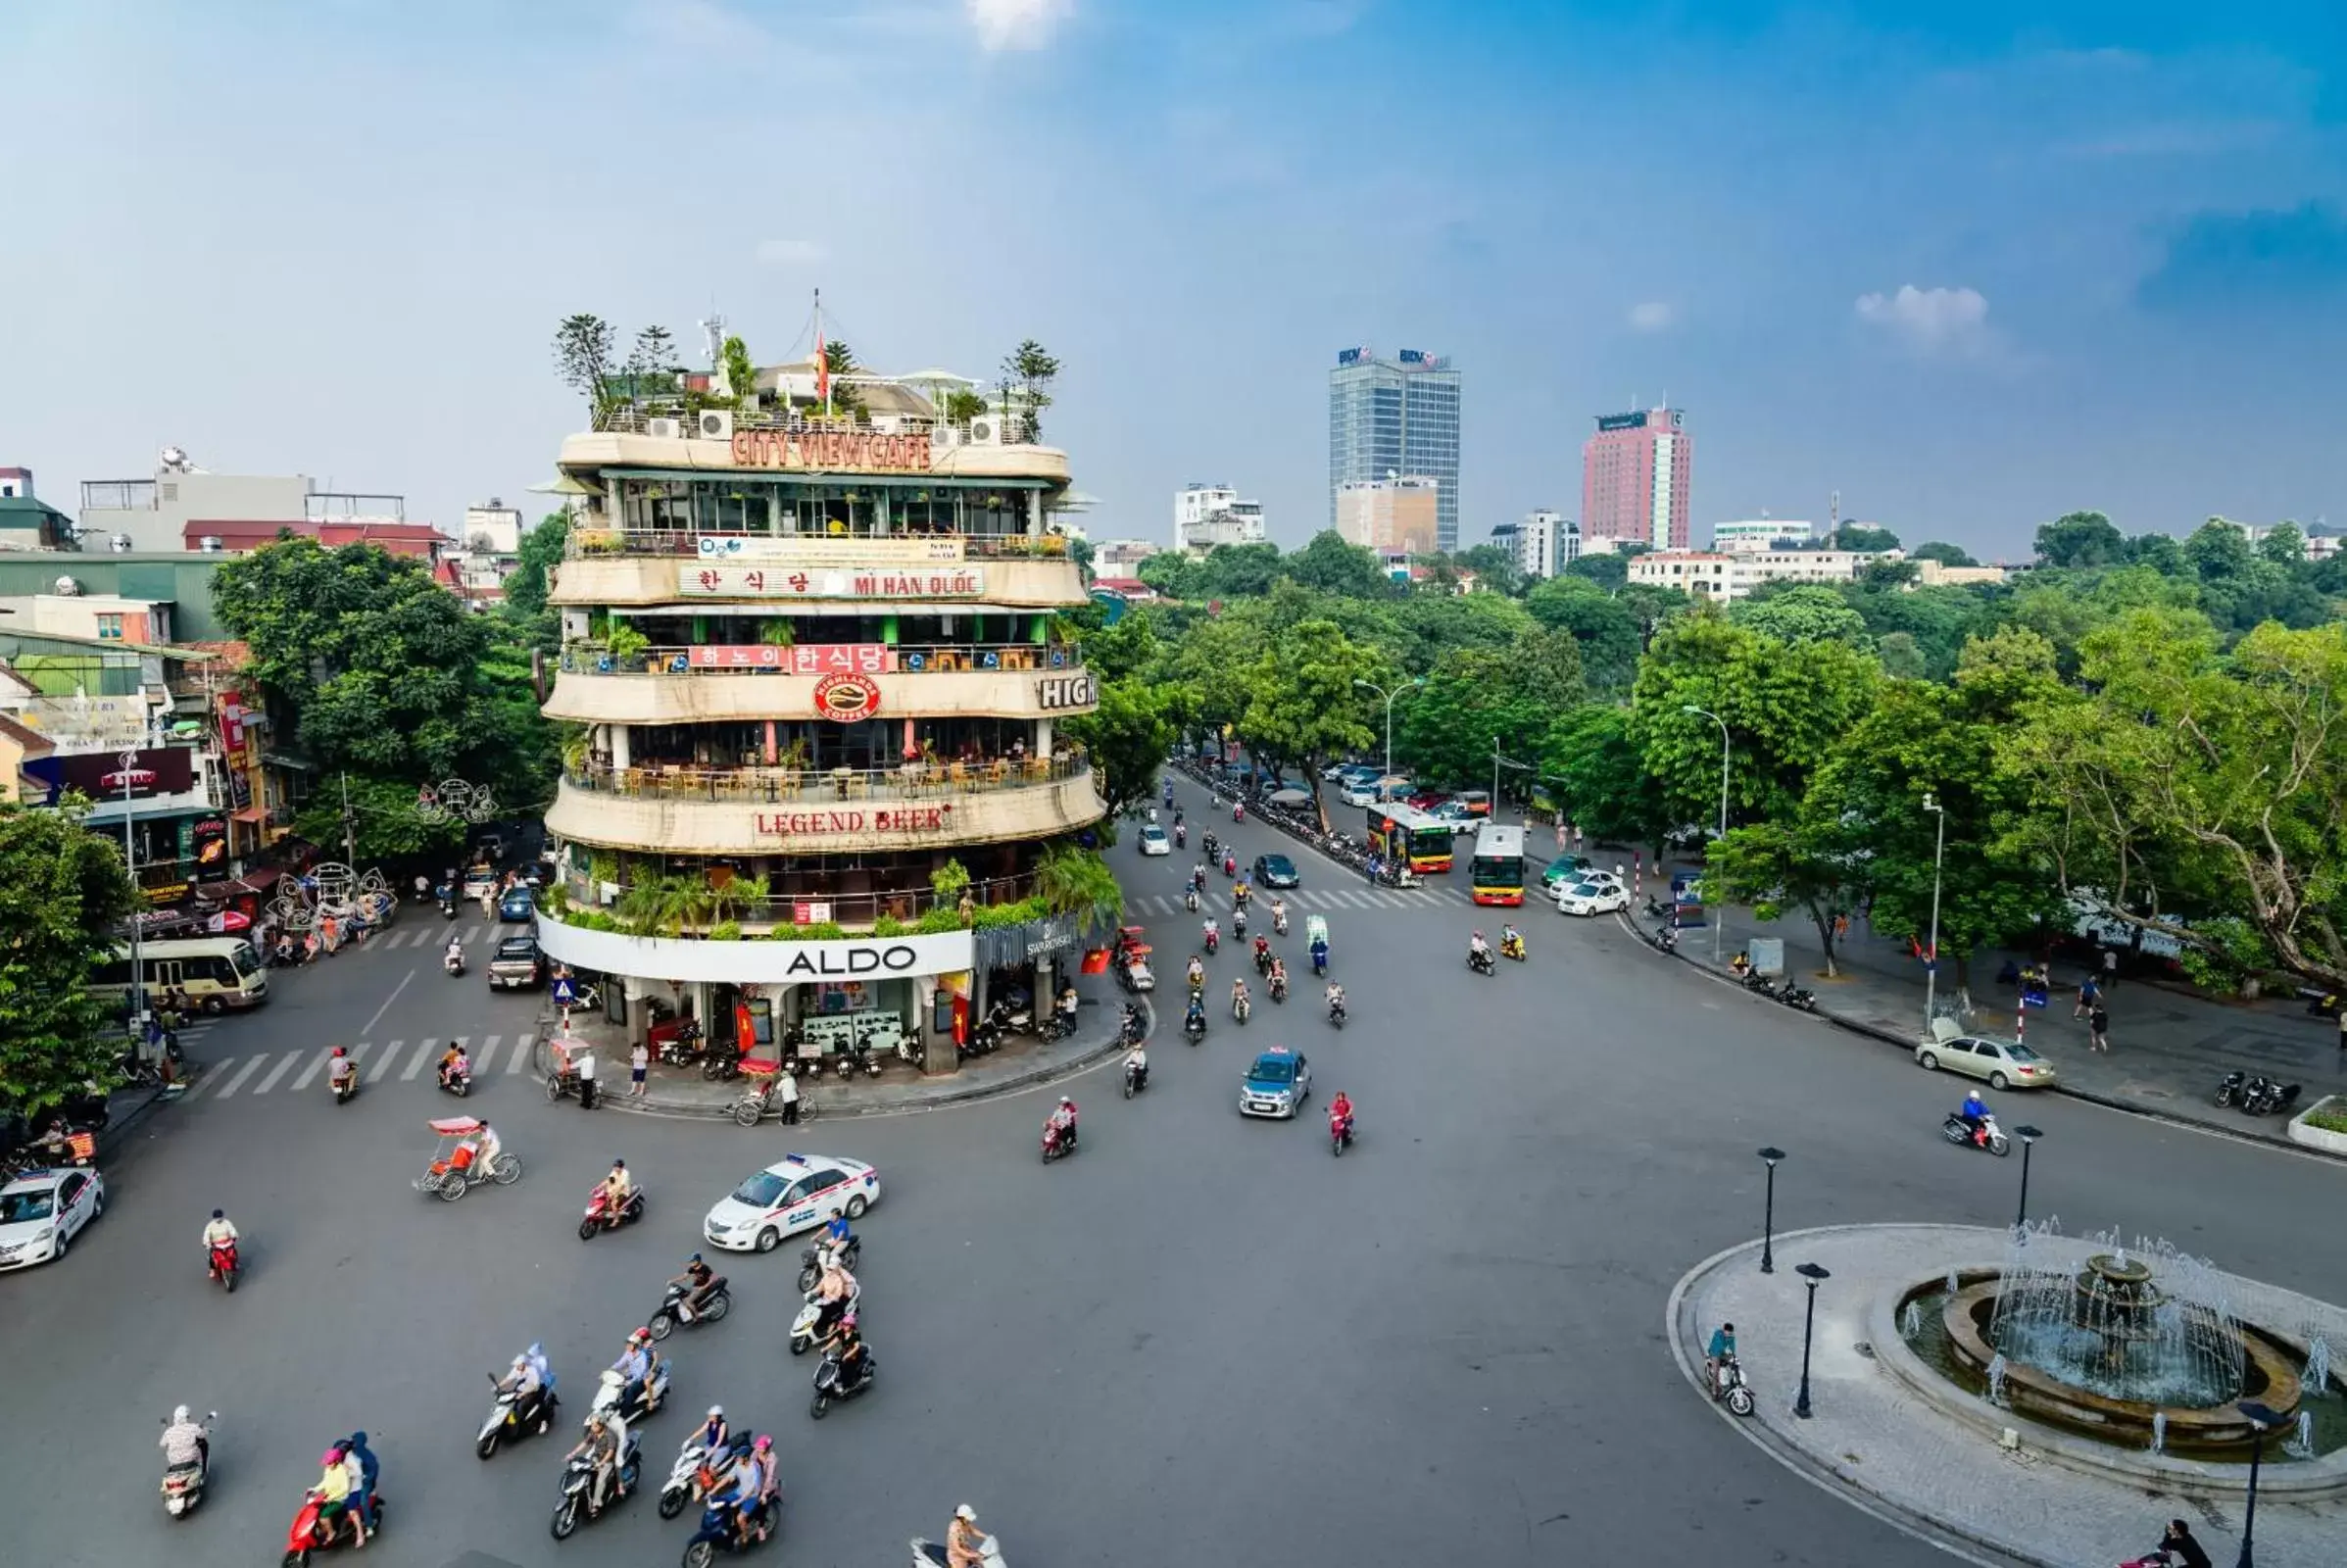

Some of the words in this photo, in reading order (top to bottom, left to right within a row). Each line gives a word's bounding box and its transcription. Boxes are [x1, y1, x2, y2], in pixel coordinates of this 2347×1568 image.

[732, 428, 787, 466] CITY
[800, 432, 863, 466] VIEW
[868, 434, 931, 468] CAFE
[883, 570, 922, 595] HÀN
[930, 568, 977, 595] QUỐC
[701, 646, 778, 664] 하노이
[795, 645, 883, 672] 한식당
[817, 674, 877, 697] HIGHLANDS
[823, 707, 870, 720] COFFEE
[758, 809, 864, 835] LEGEND
[875, 807, 942, 831] BEER
[786, 945, 917, 975] ALDO
